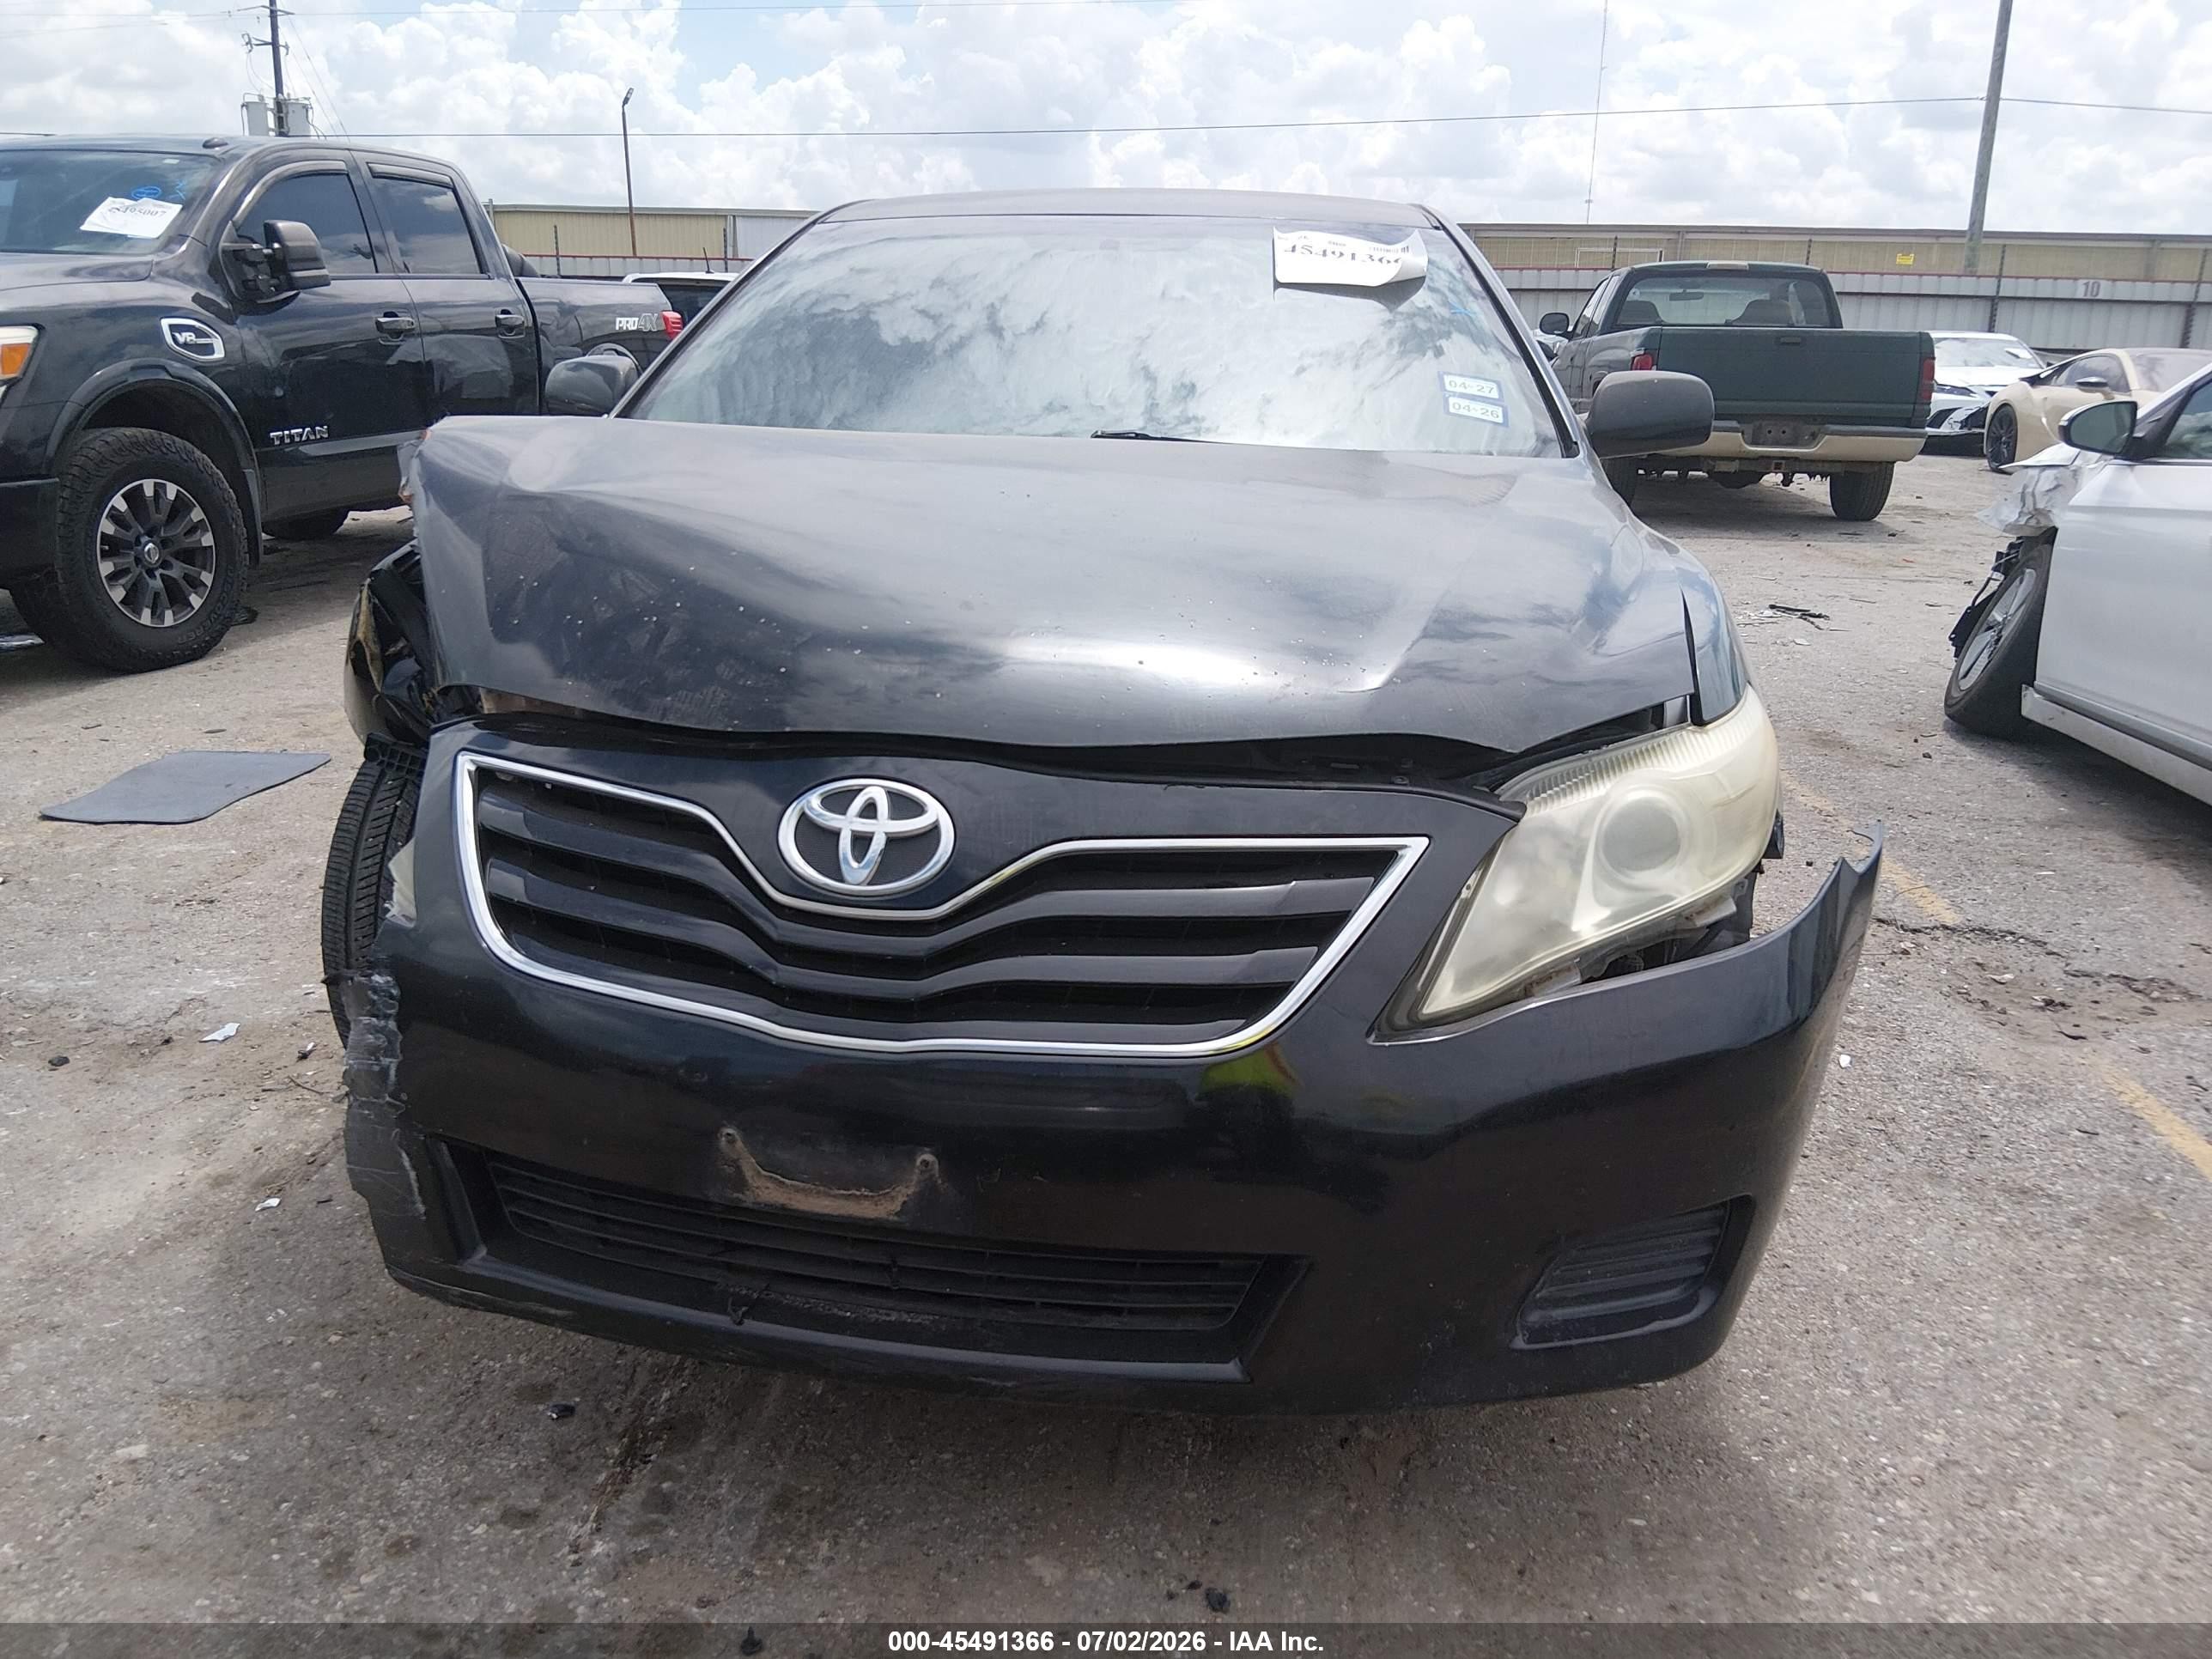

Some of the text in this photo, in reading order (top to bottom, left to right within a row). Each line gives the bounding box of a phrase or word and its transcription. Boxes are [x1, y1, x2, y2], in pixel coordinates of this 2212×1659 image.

[2081, 280, 2100, 298] 10
[171, 331, 197, 344] V8
[270, 425, 329, 446] TITAN
